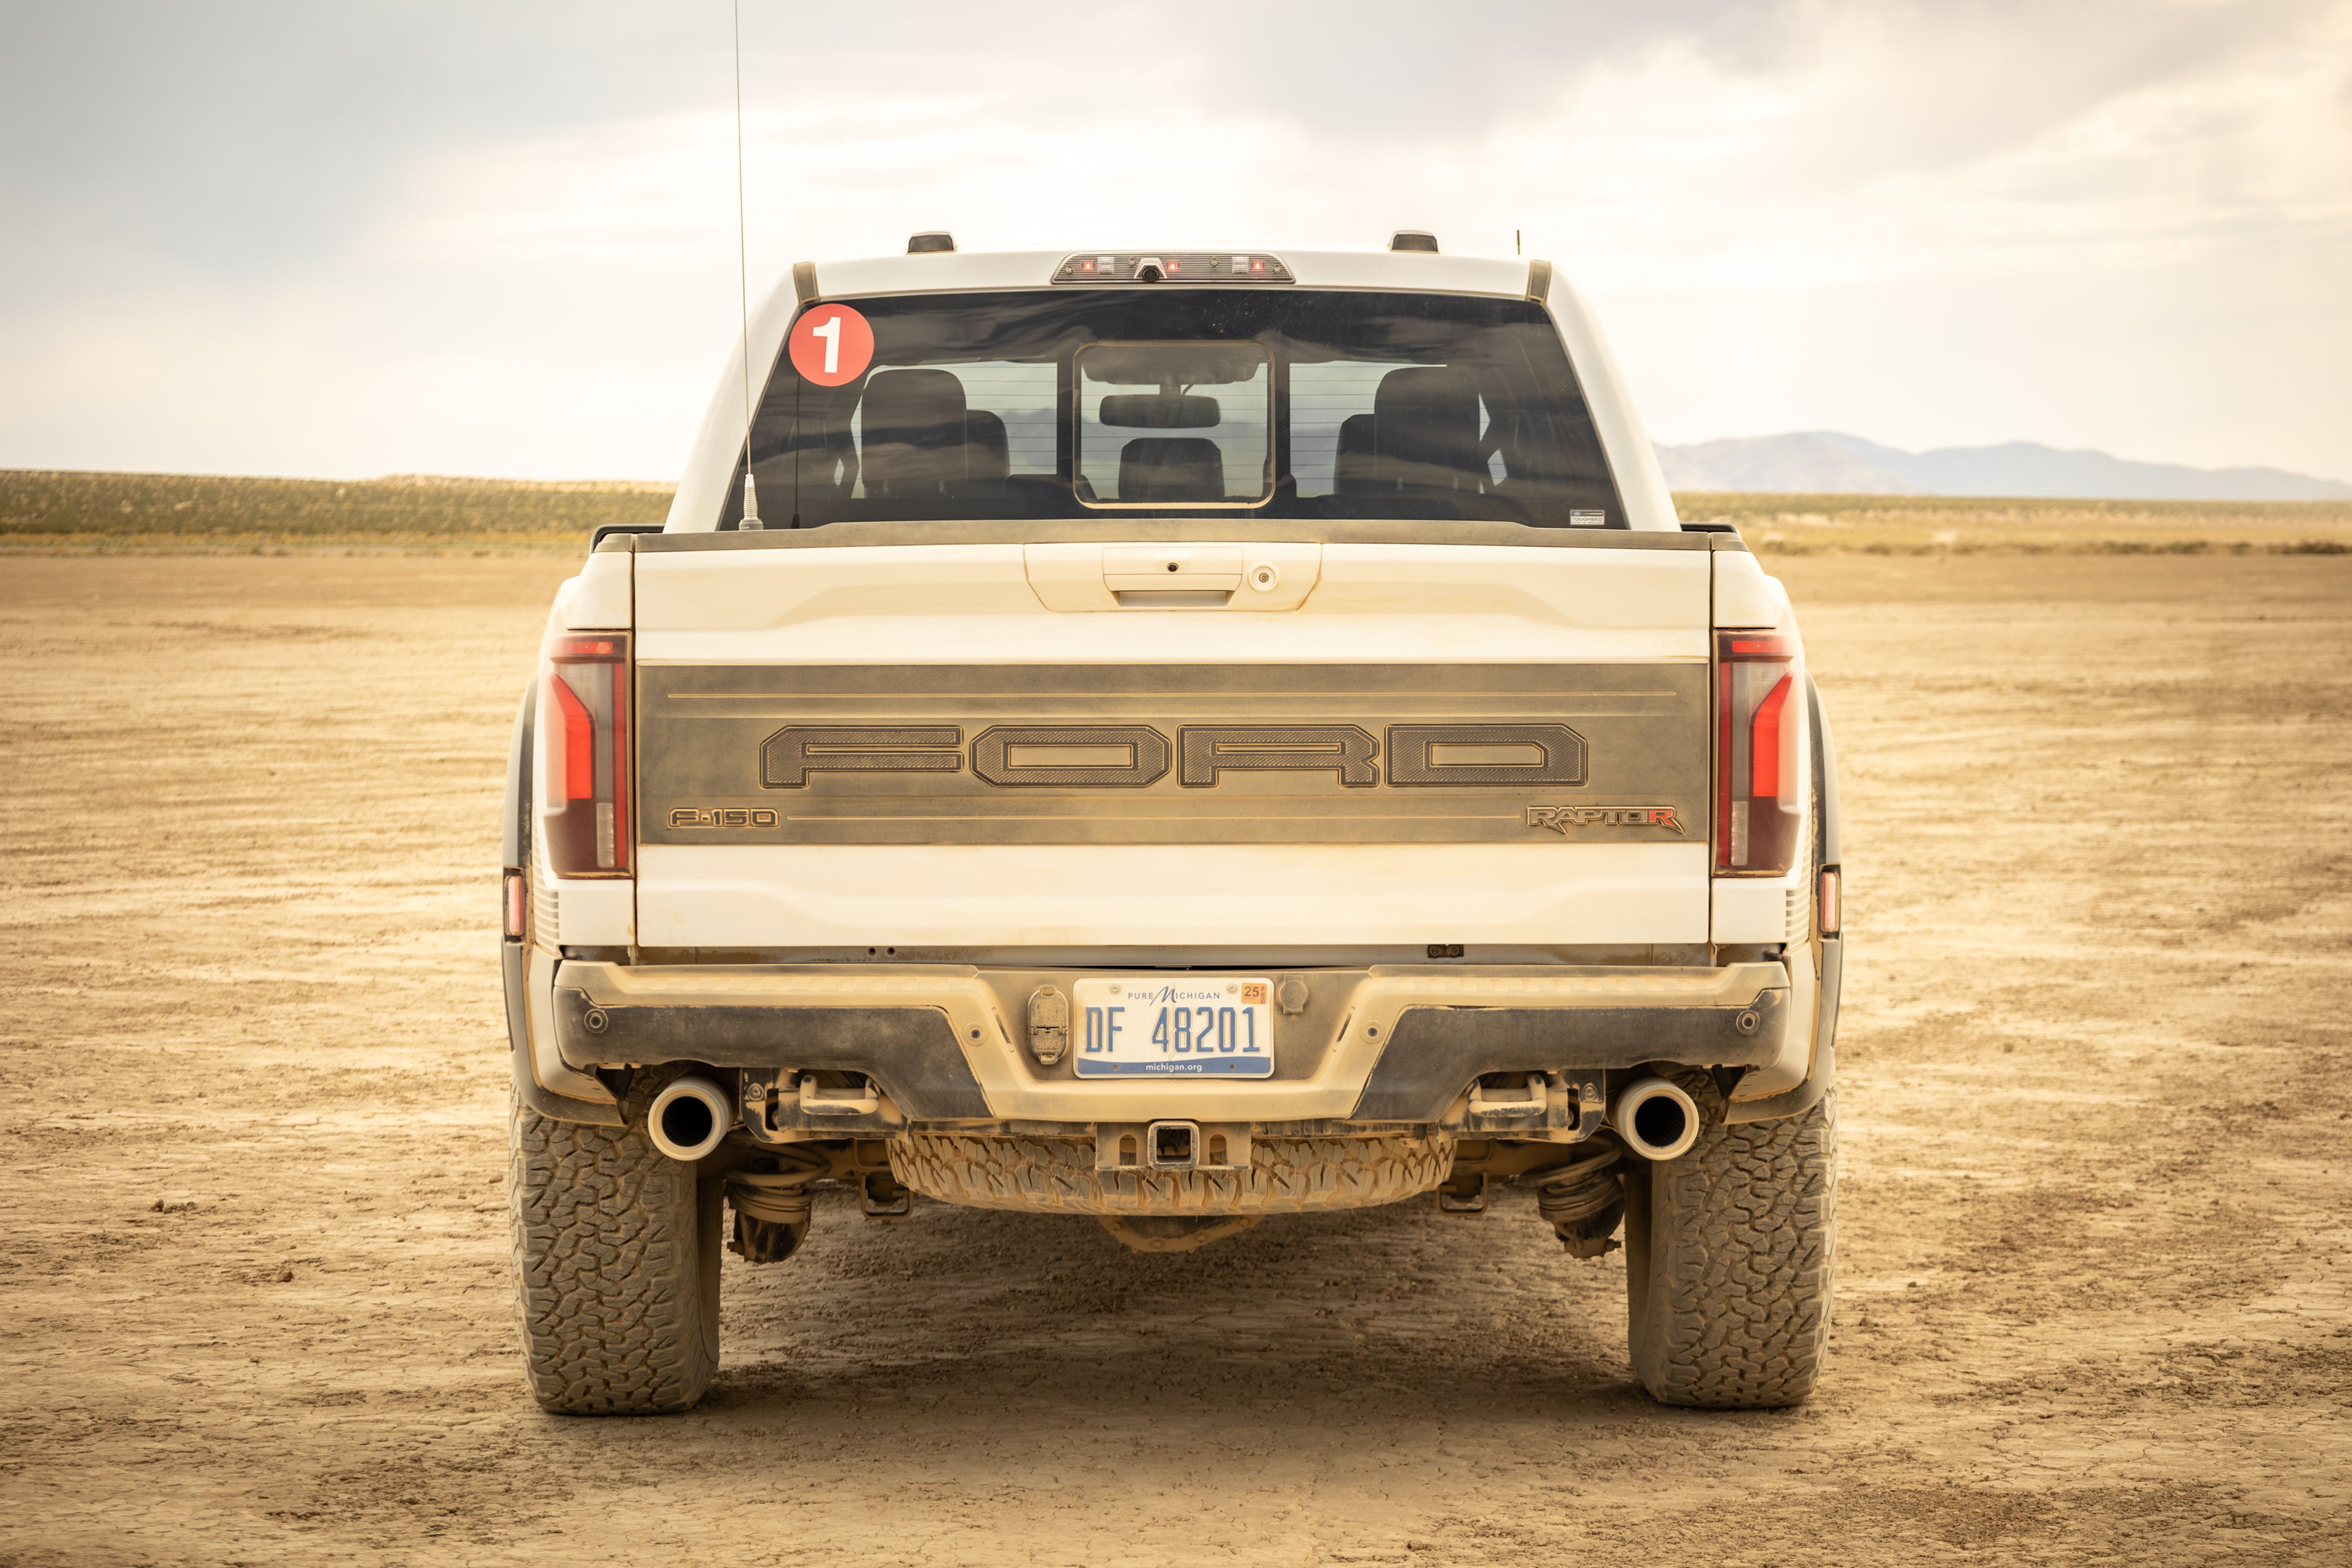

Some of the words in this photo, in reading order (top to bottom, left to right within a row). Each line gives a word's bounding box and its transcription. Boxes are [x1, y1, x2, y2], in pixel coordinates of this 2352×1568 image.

[813, 316, 841, 373] 1
[760, 724, 1588, 789] FORD
[668, 808, 779, 827] F-150
[1527, 806, 1685, 835] RAPTOR
[1149, 986, 1220, 1006] MICHIGAN
[1244, 986, 1259, 997] 25
[1085, 1006, 1125, 1052] DF
[1152, 1006, 1260, 1052] 48201
[1146, 1064, 1202, 1072] michigan.org
